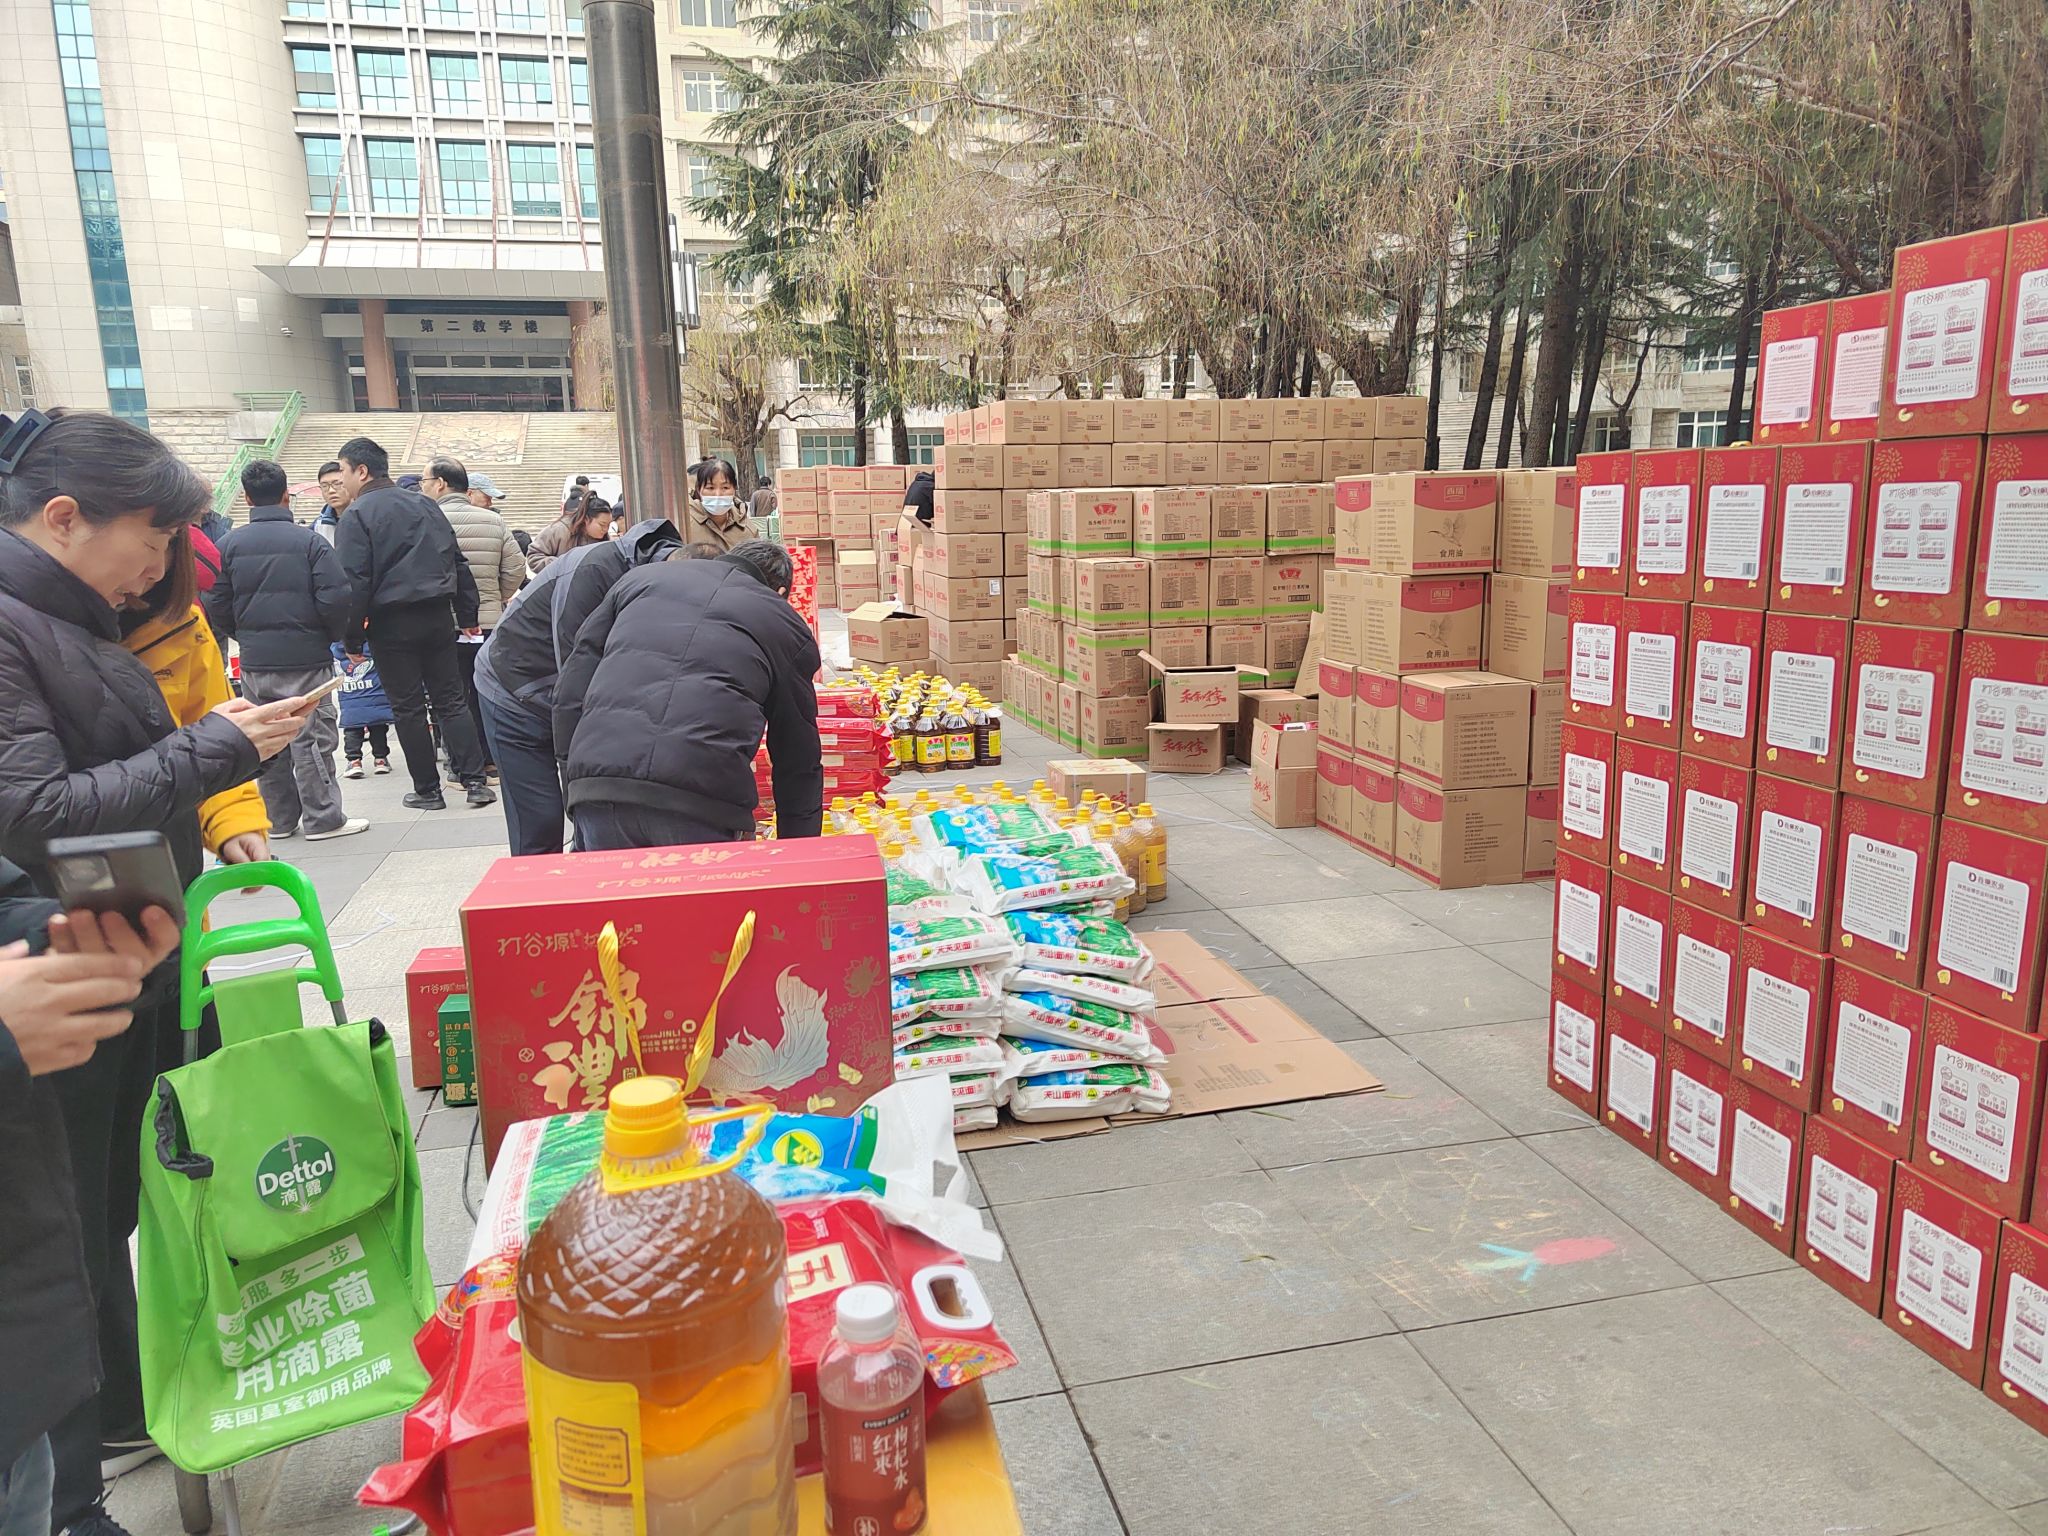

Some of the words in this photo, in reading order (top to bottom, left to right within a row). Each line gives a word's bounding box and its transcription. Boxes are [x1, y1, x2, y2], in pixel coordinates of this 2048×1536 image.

[420, 318, 538, 334] 第二教学楼
[1440, 549, 1463, 558] 食用油
[1426, 649, 1449, 659] 食用油
[1022, 887, 1056, 899] 天山面粉
[1075, 881, 1104, 891] 天天见面
[936, 941, 971, 954] 天天见面
[1037, 949, 1074, 960] 天山面粉
[1092, 956, 1126, 969] 天天见面
[1028, 1009, 1065, 1027] 天山面粉
[1081, 1025, 1117, 1041] 天天见面
[926, 1054, 963, 1065] 天天见面
[1050, 1054, 1086, 1063] 天山面粉
[1043, 1090, 1082, 1100] 天山面粉
[258, 1151, 334, 1196] Dettol
[280, 1179, 322, 1206] 滴露
[280, 1244, 350, 1290] 多一步
[234, 1320, 364, 1400] 用滴露
[210, 1358, 393, 1433] 英国皇室御用品牌
[872, 1434, 893, 1476] 红枣
[893, 1424, 909, 1491] 枸杞水
